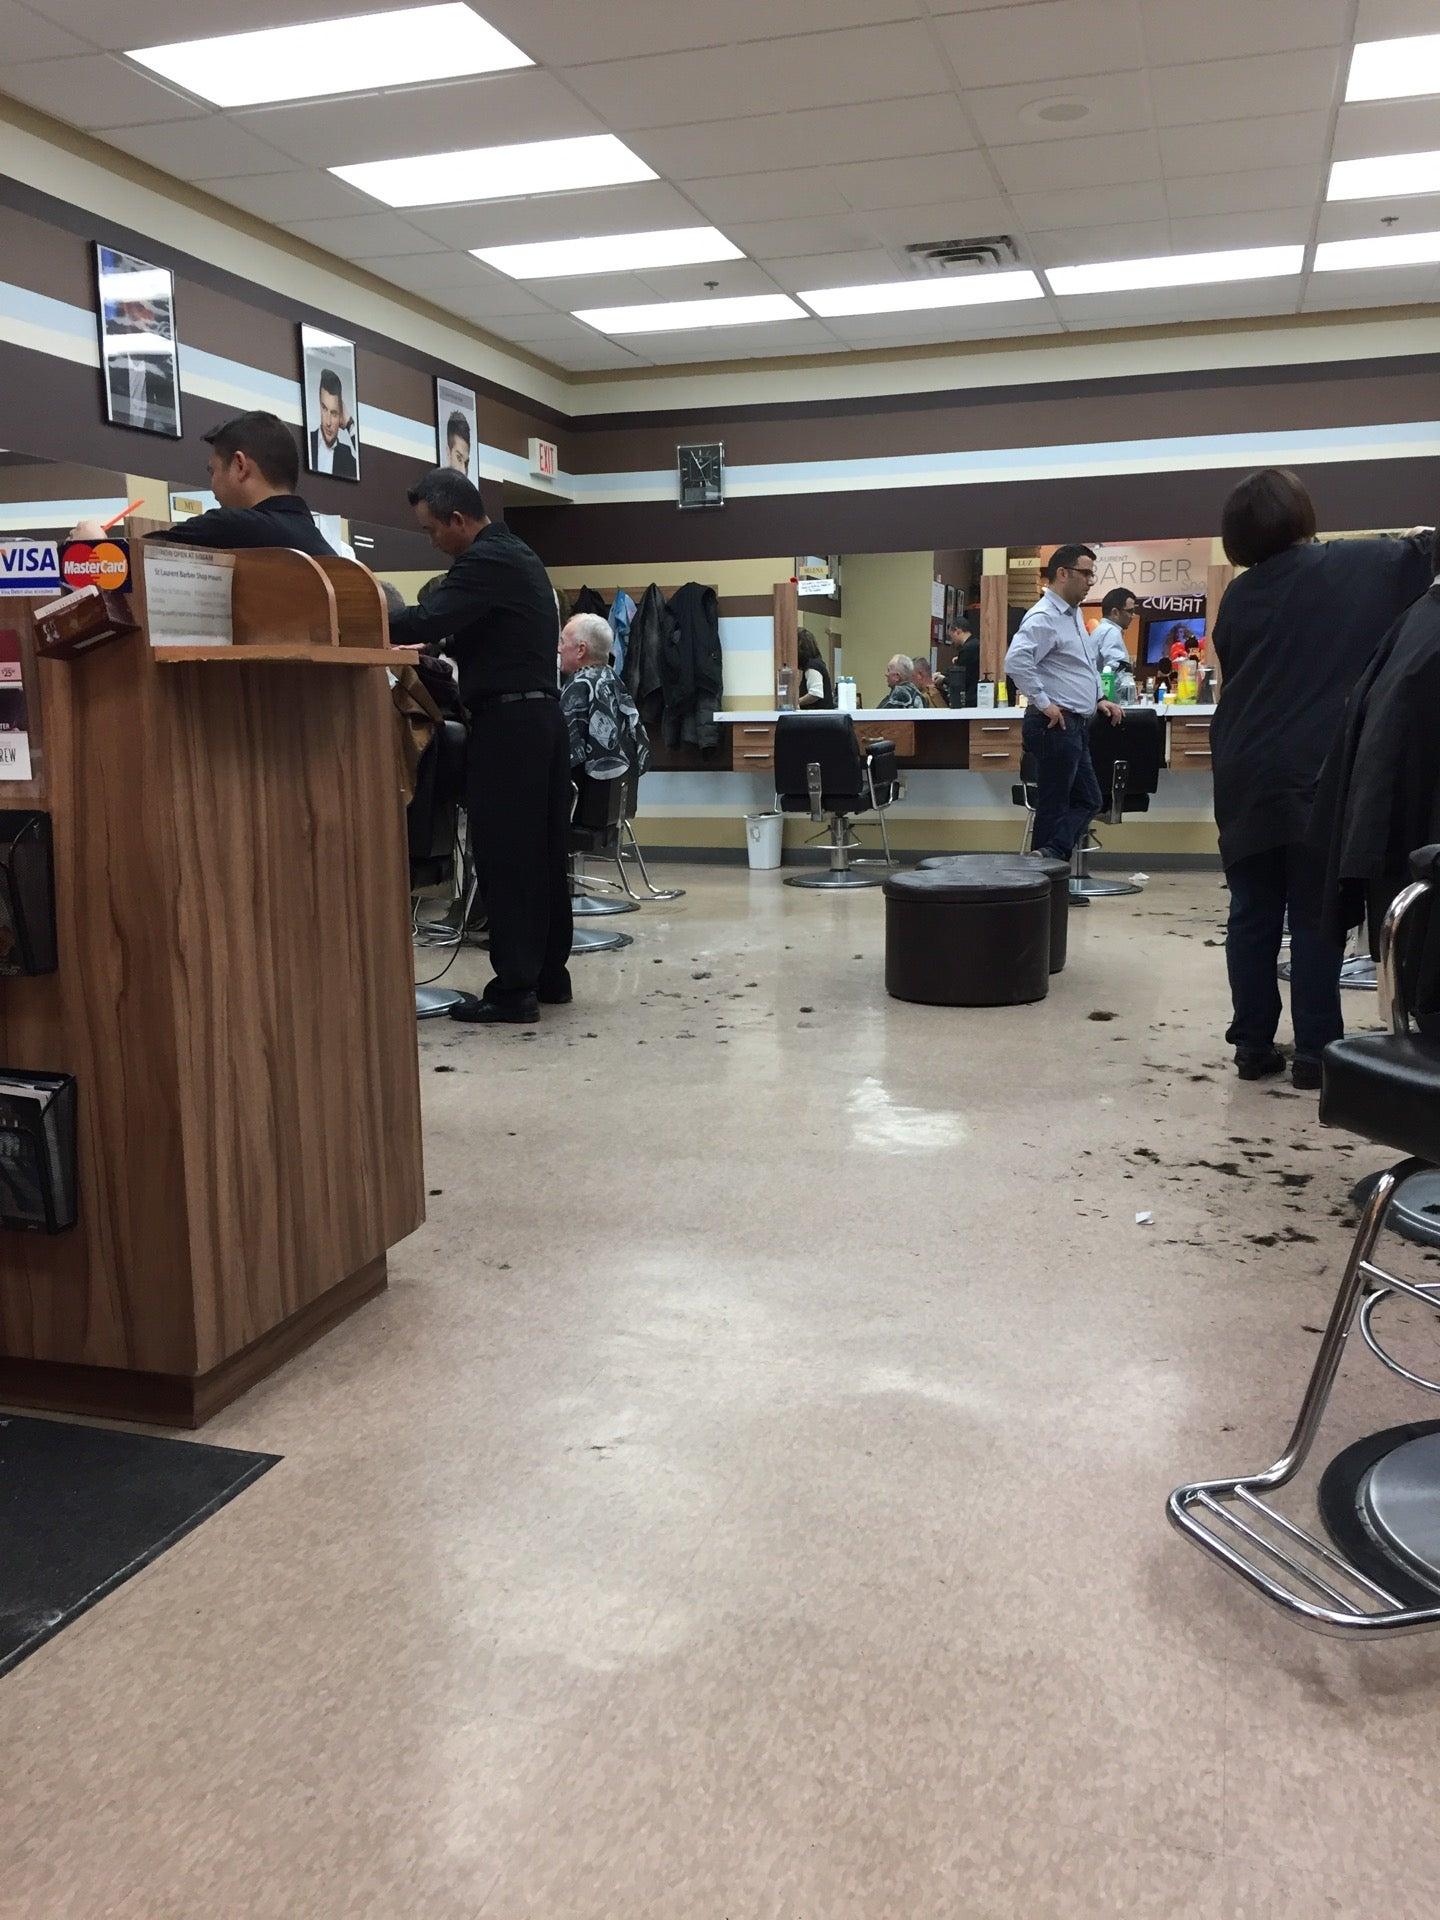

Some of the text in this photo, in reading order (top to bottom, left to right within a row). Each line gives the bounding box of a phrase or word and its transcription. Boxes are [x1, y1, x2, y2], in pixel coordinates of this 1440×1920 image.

[539, 443, 554, 475] EXIT
[0, 548, 57, 572] VISA
[64, 560, 126, 575] MasterCard
